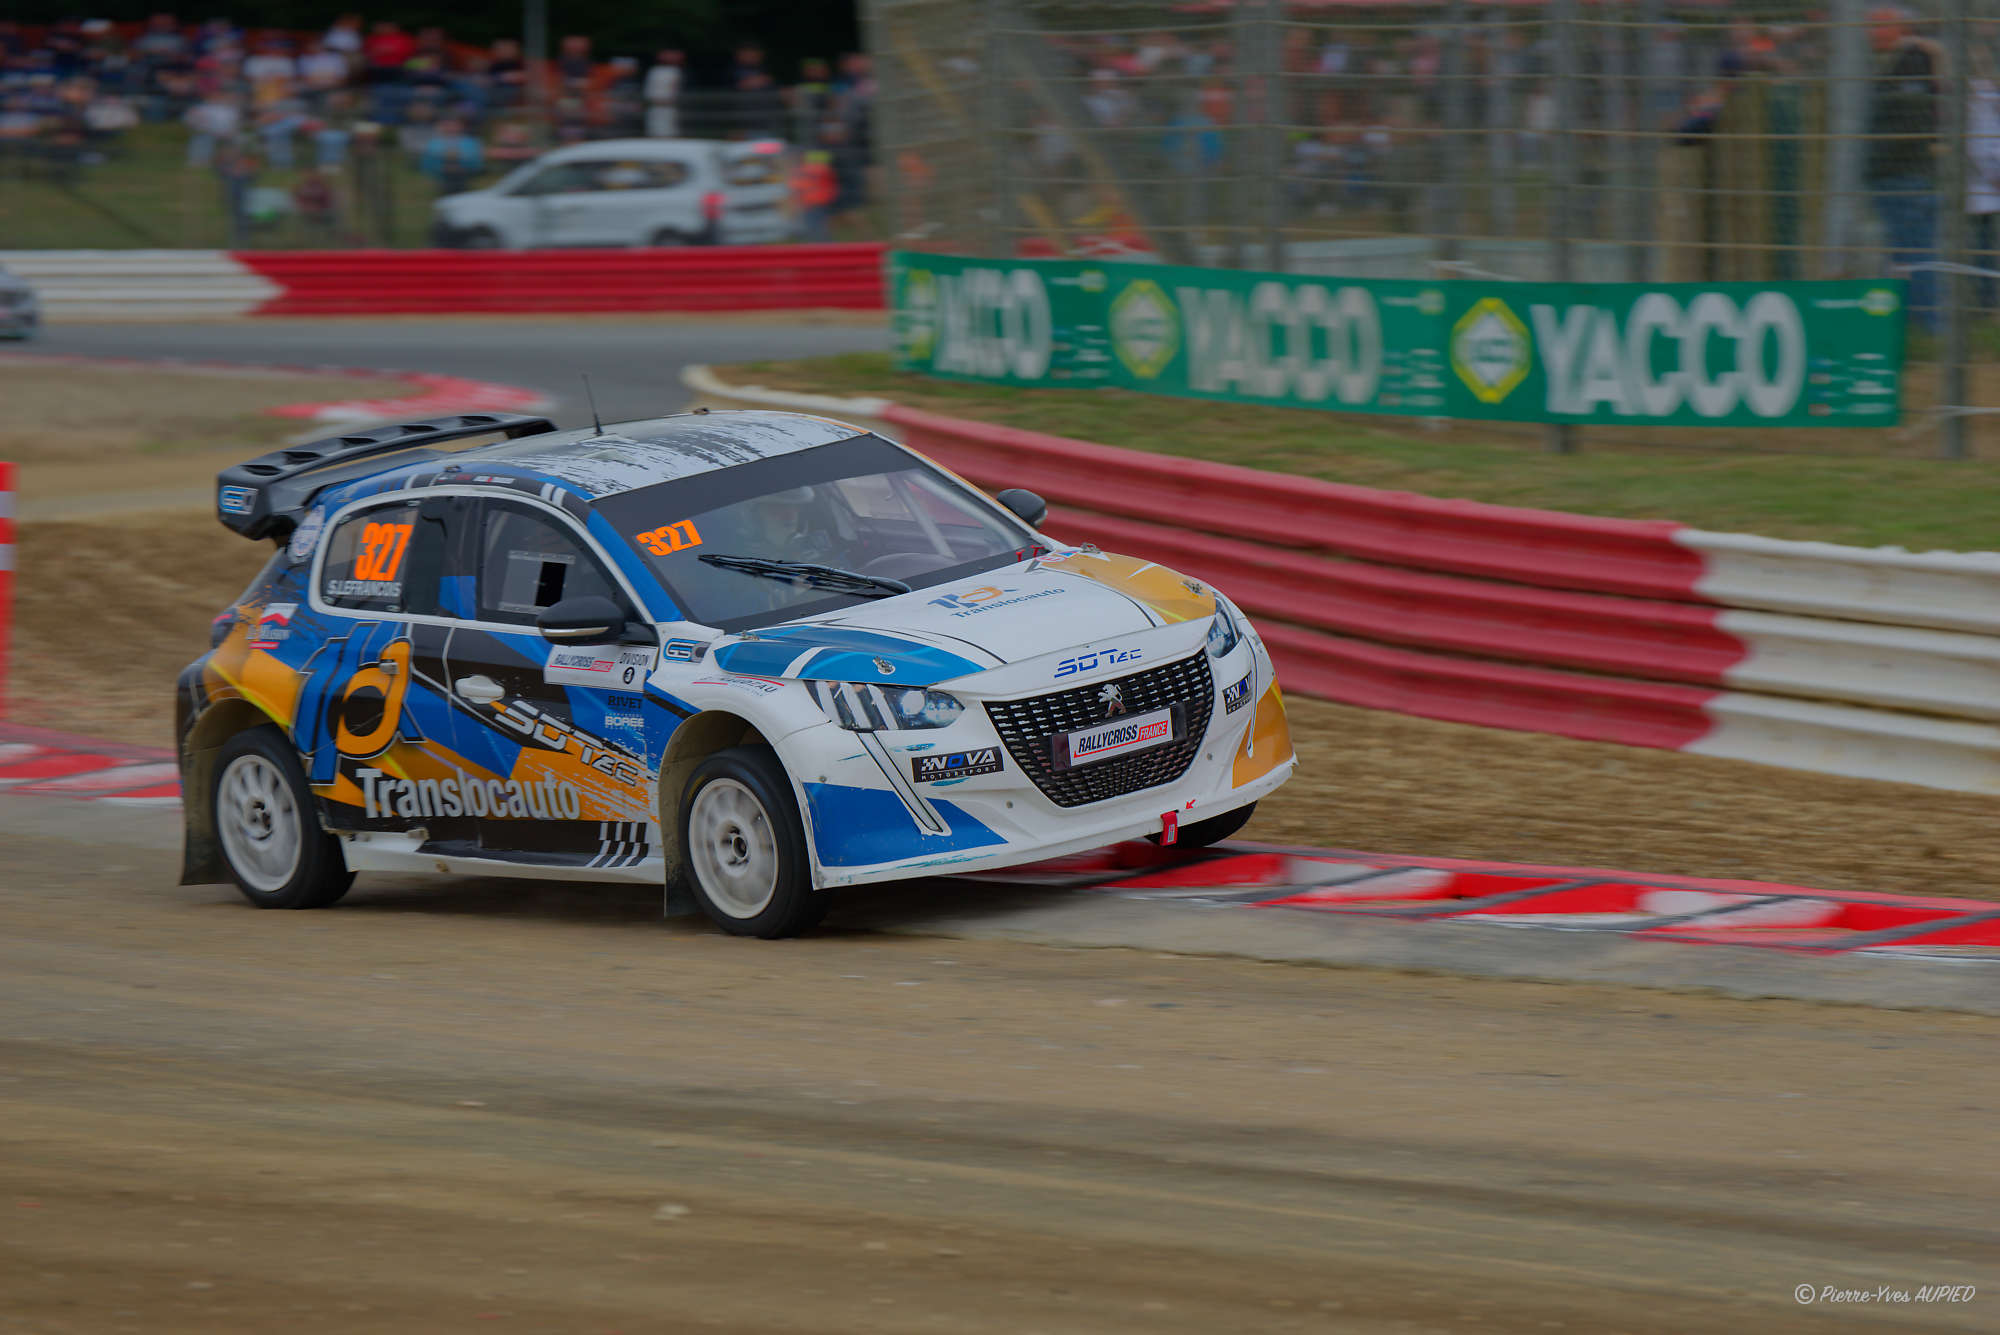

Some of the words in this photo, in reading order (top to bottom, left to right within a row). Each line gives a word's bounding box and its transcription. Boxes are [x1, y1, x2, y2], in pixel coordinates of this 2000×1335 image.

[1176, 281, 1383, 404] YACCO
[1530, 291, 1806, 417] YACCO
[354, 522, 415, 581] 327
[635, 519, 703, 556] 327
[949, 588, 1066, 618] Translocauto
[1078, 724, 1138, 753] RALLYCROSS
[1140, 721, 1167, 740] FRANCE
[355, 766, 581, 819] Translocauto
[921, 765, 997, 781] MOTORSPORT
